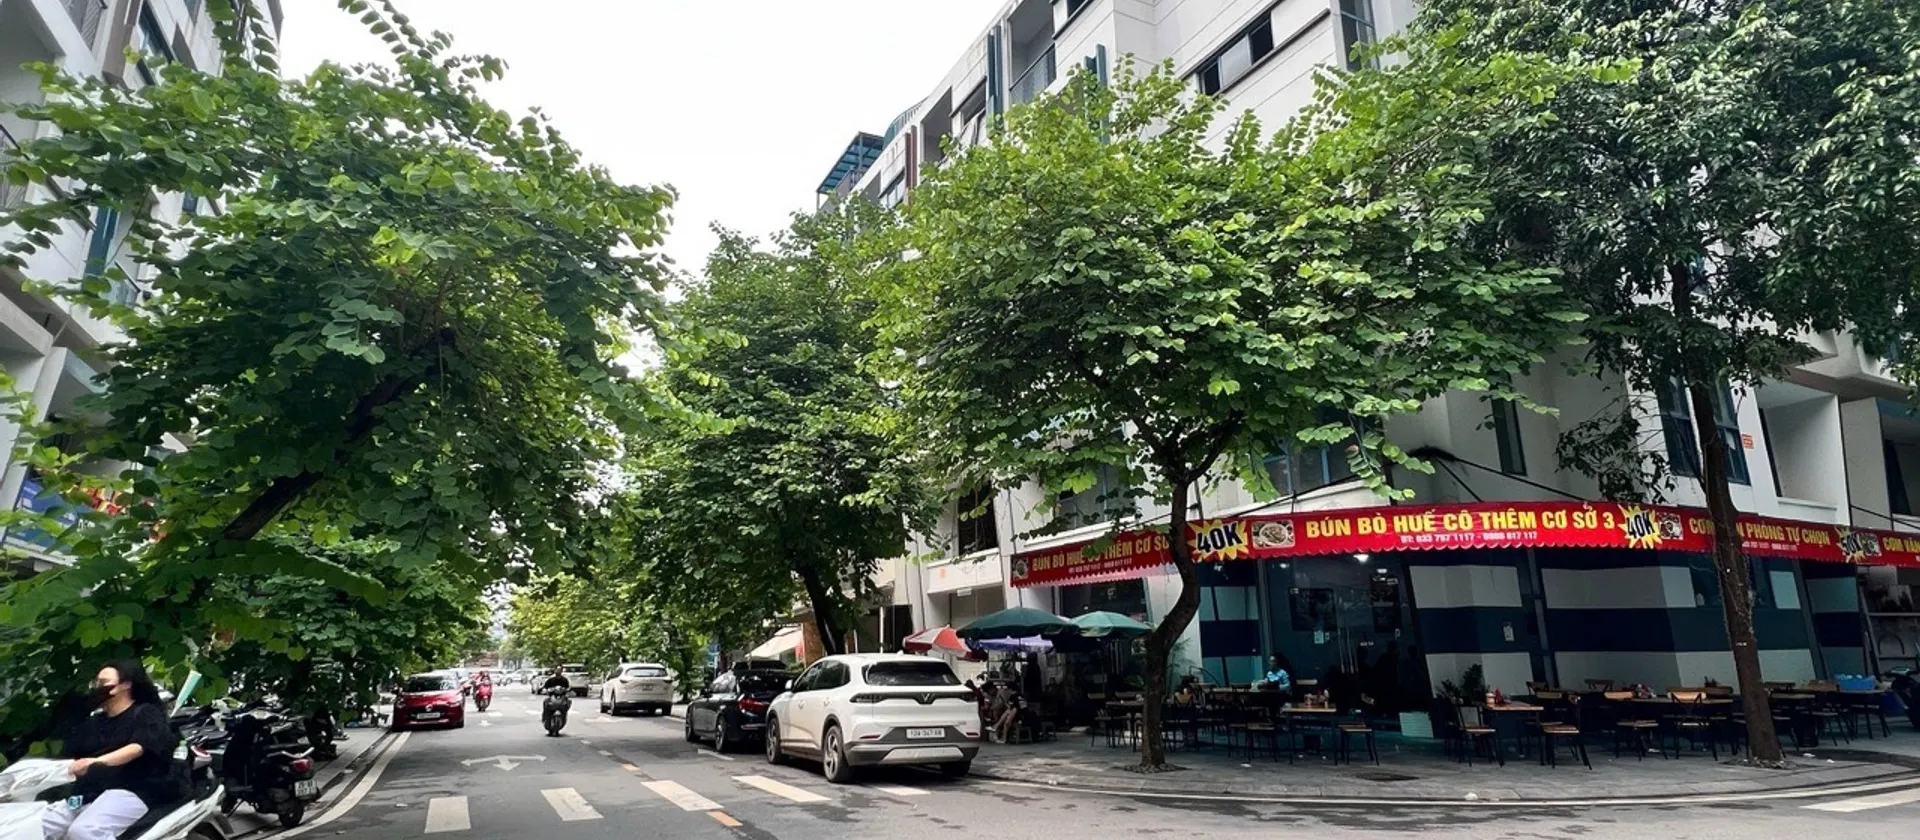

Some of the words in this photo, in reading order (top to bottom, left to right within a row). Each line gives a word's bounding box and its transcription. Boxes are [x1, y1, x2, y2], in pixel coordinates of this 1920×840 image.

[1305, 516, 1351, 538] BÚN
[1357, 512, 1388, 534] BÒ
[1393, 508, 1437, 533] HUẾ
[1443, 509, 1474, 531] CÔ
[1478, 508, 1537, 530] THÊM
[1541, 509, 1568, 529] CƠ
[1573, 501, 1598, 529] SỞ
[1602, 511, 1616, 529] 3
[1626, 511, 1656, 539] 40K
[1745, 520, 1785, 541] PHÒNG
[1785, 526, 1801, 546] TỰ
[1801, 529, 1831, 548] CHỌN
[1197, 522, 1243, 553] 40K
[1882, 536, 1904, 552] CƠM
[1031, 554, 1050, 571] BÚN
[1052, 551, 1065, 568] BÒ
[1135, 537, 1151, 554] CƠ
